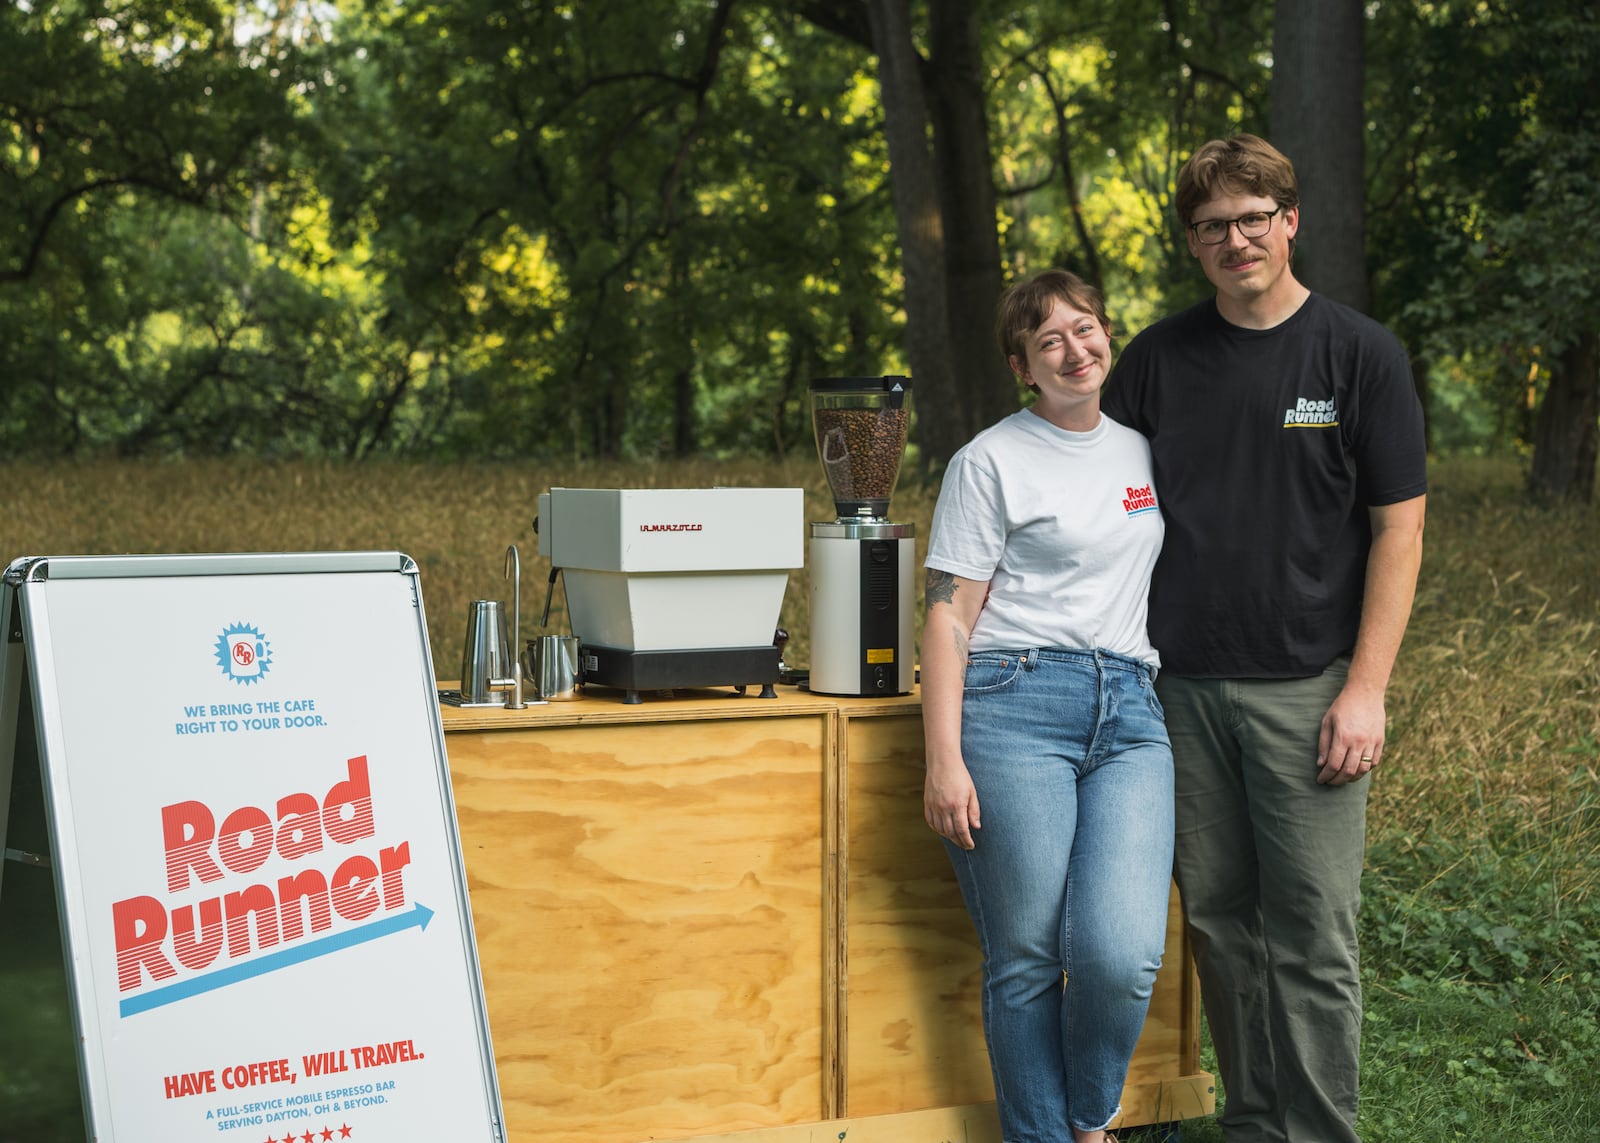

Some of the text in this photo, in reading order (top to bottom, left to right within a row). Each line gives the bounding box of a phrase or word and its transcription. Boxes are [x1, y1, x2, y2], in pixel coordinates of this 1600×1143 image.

[1296, 396, 1334, 412] Road
[1284, 409, 1337, 423] Runner
[1126, 484, 1152, 500] Road
[1122, 497, 1156, 511] Runne
[184, 699, 315, 718] WE BRING THE CAFE
[175, 715, 327, 735] RIGHT TO YOUR DOOR.
[161, 755, 375, 894] Road
[112, 841, 410, 992] Runner
[164, 1039, 424, 1099] HAVE COFFEE, WILL TRAVEL.
[206, 1081, 395, 1120] A FULL-SERVICE MOBILE ESPRESSO BAR
[217, 1095, 388, 1131] SERVING DAYTON, OH & BEYOND.
